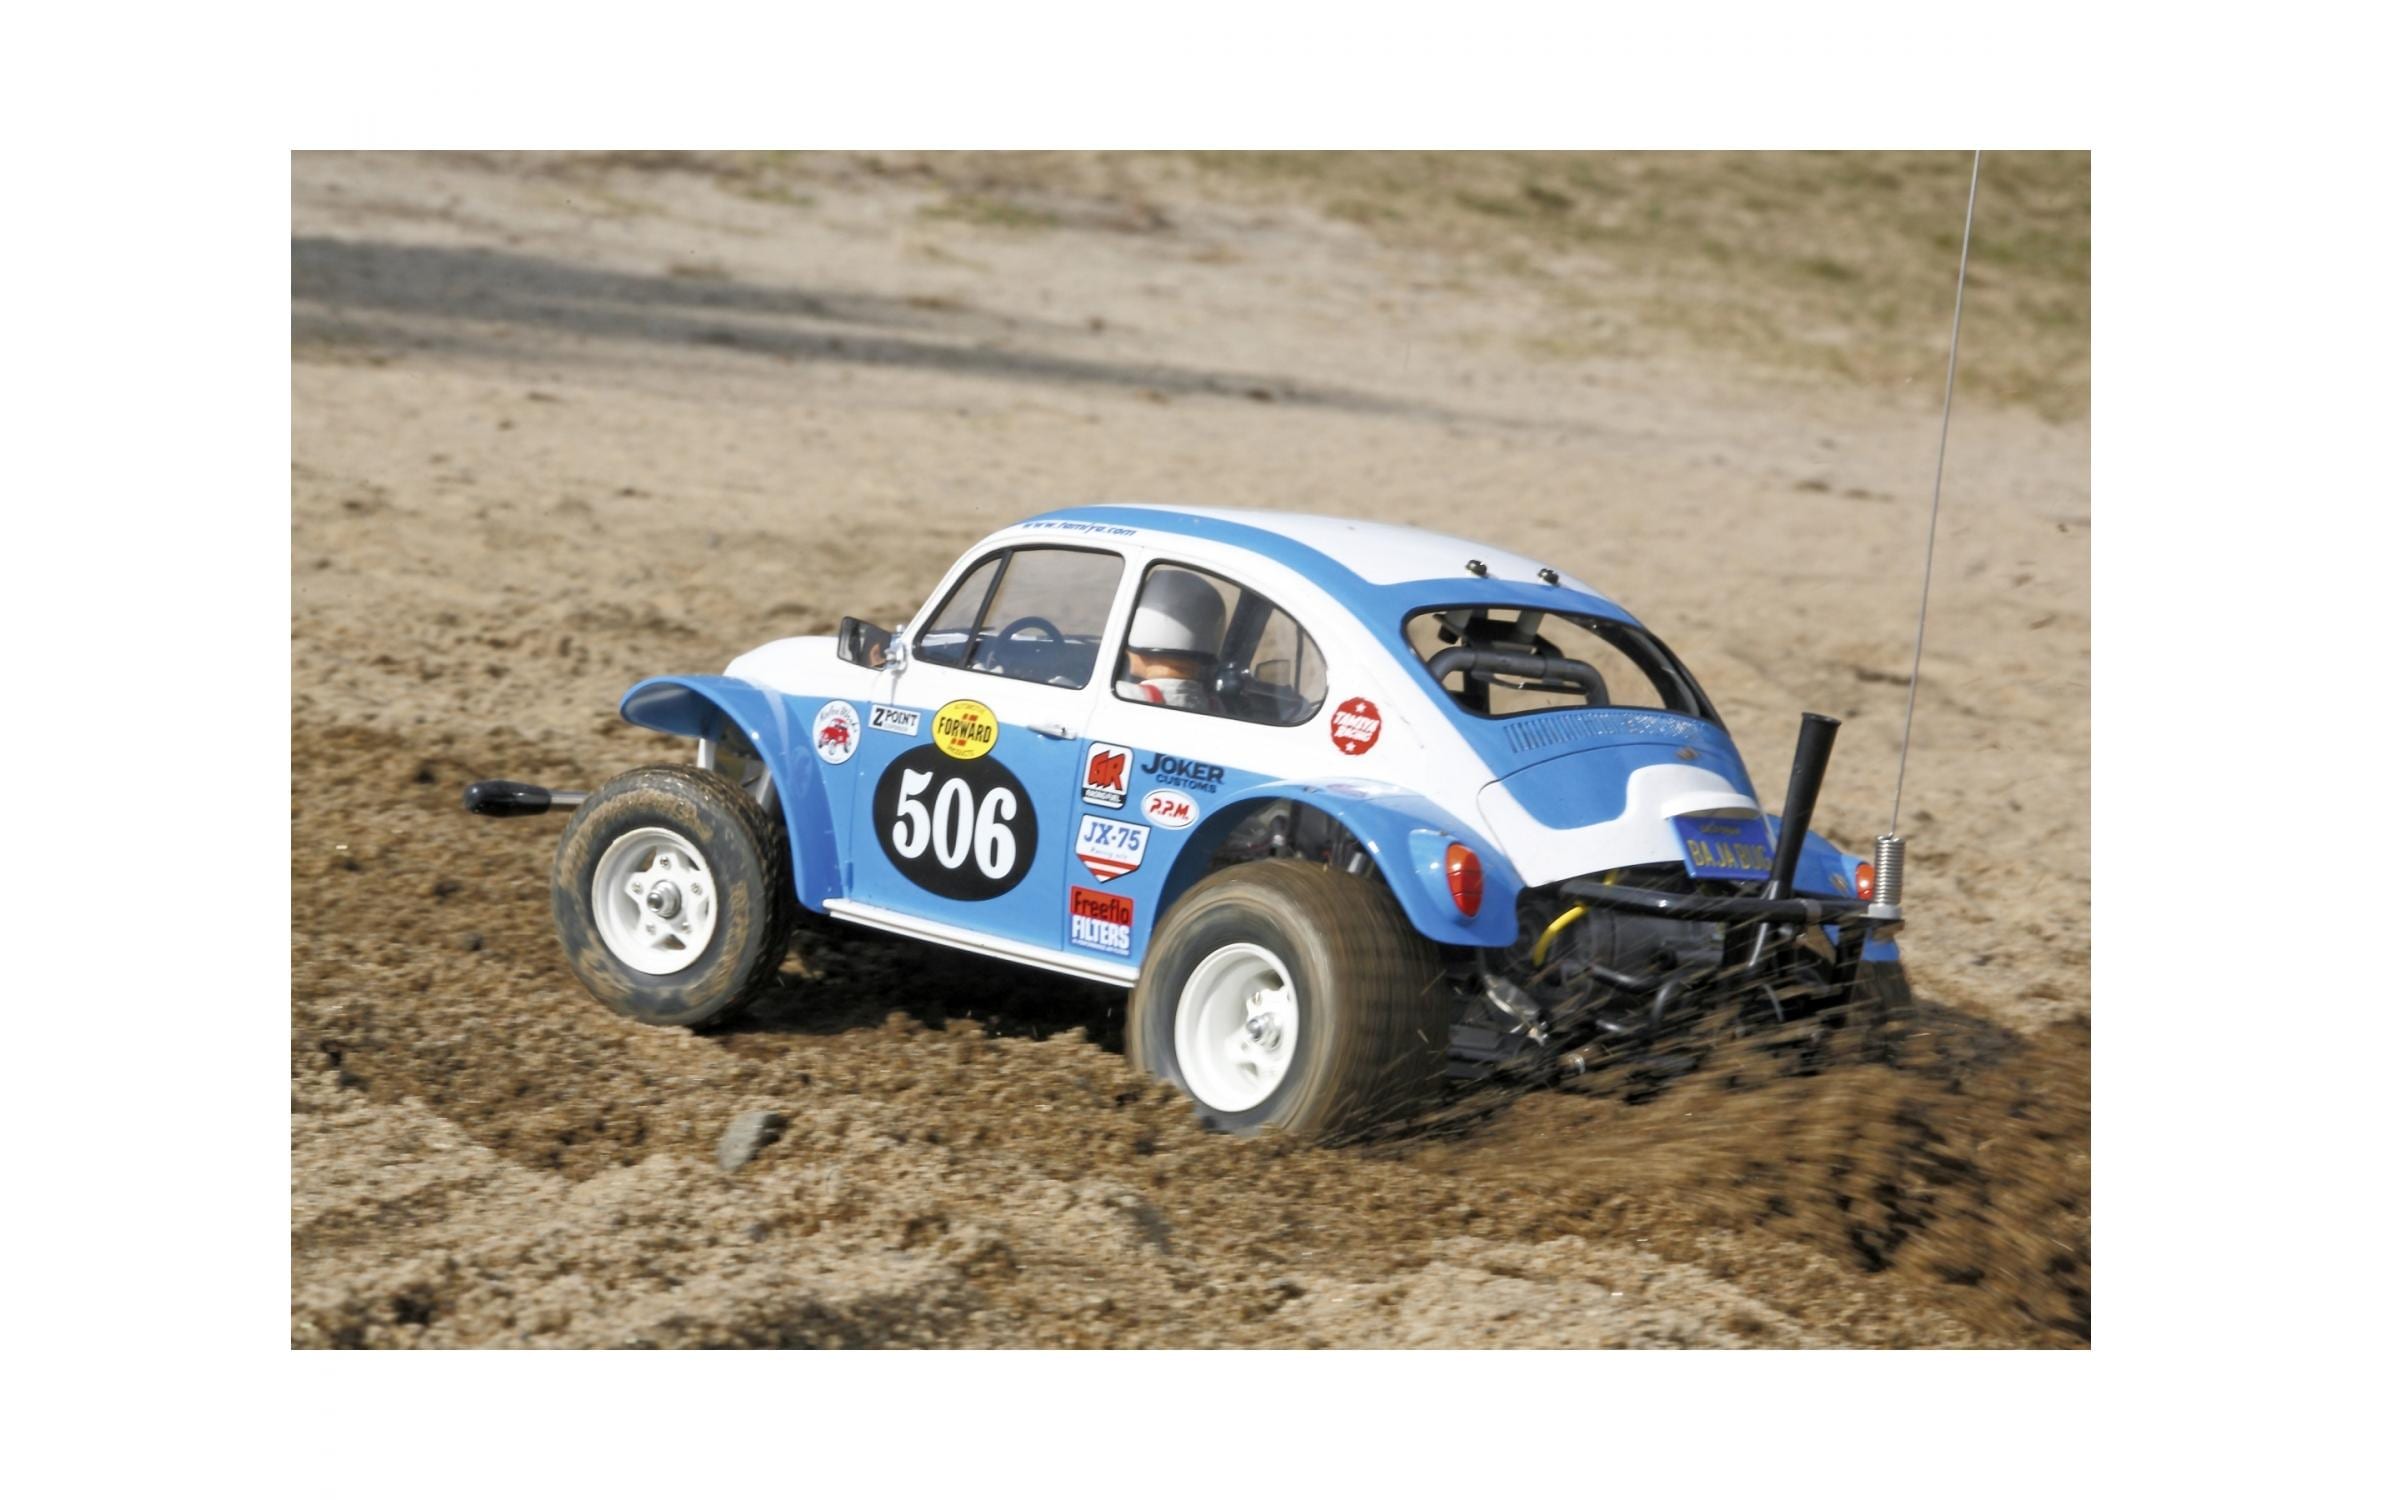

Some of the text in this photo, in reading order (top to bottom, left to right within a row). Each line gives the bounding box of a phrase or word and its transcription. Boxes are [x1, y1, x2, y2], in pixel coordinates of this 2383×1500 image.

[885, 709, 918, 728] POINT
[937, 716, 992, 743] FORWARD
[1333, 710, 1380, 733] TAMIYA
[1141, 753, 1225, 785] JOKER
[1156, 774, 1217, 794] CUSTOMS
[892, 768, 1017, 879] 506
[1084, 822, 1141, 851] JX-75
[1074, 891, 1129, 925] Freeflo
[1072, 915, 1130, 949] FILTERS
